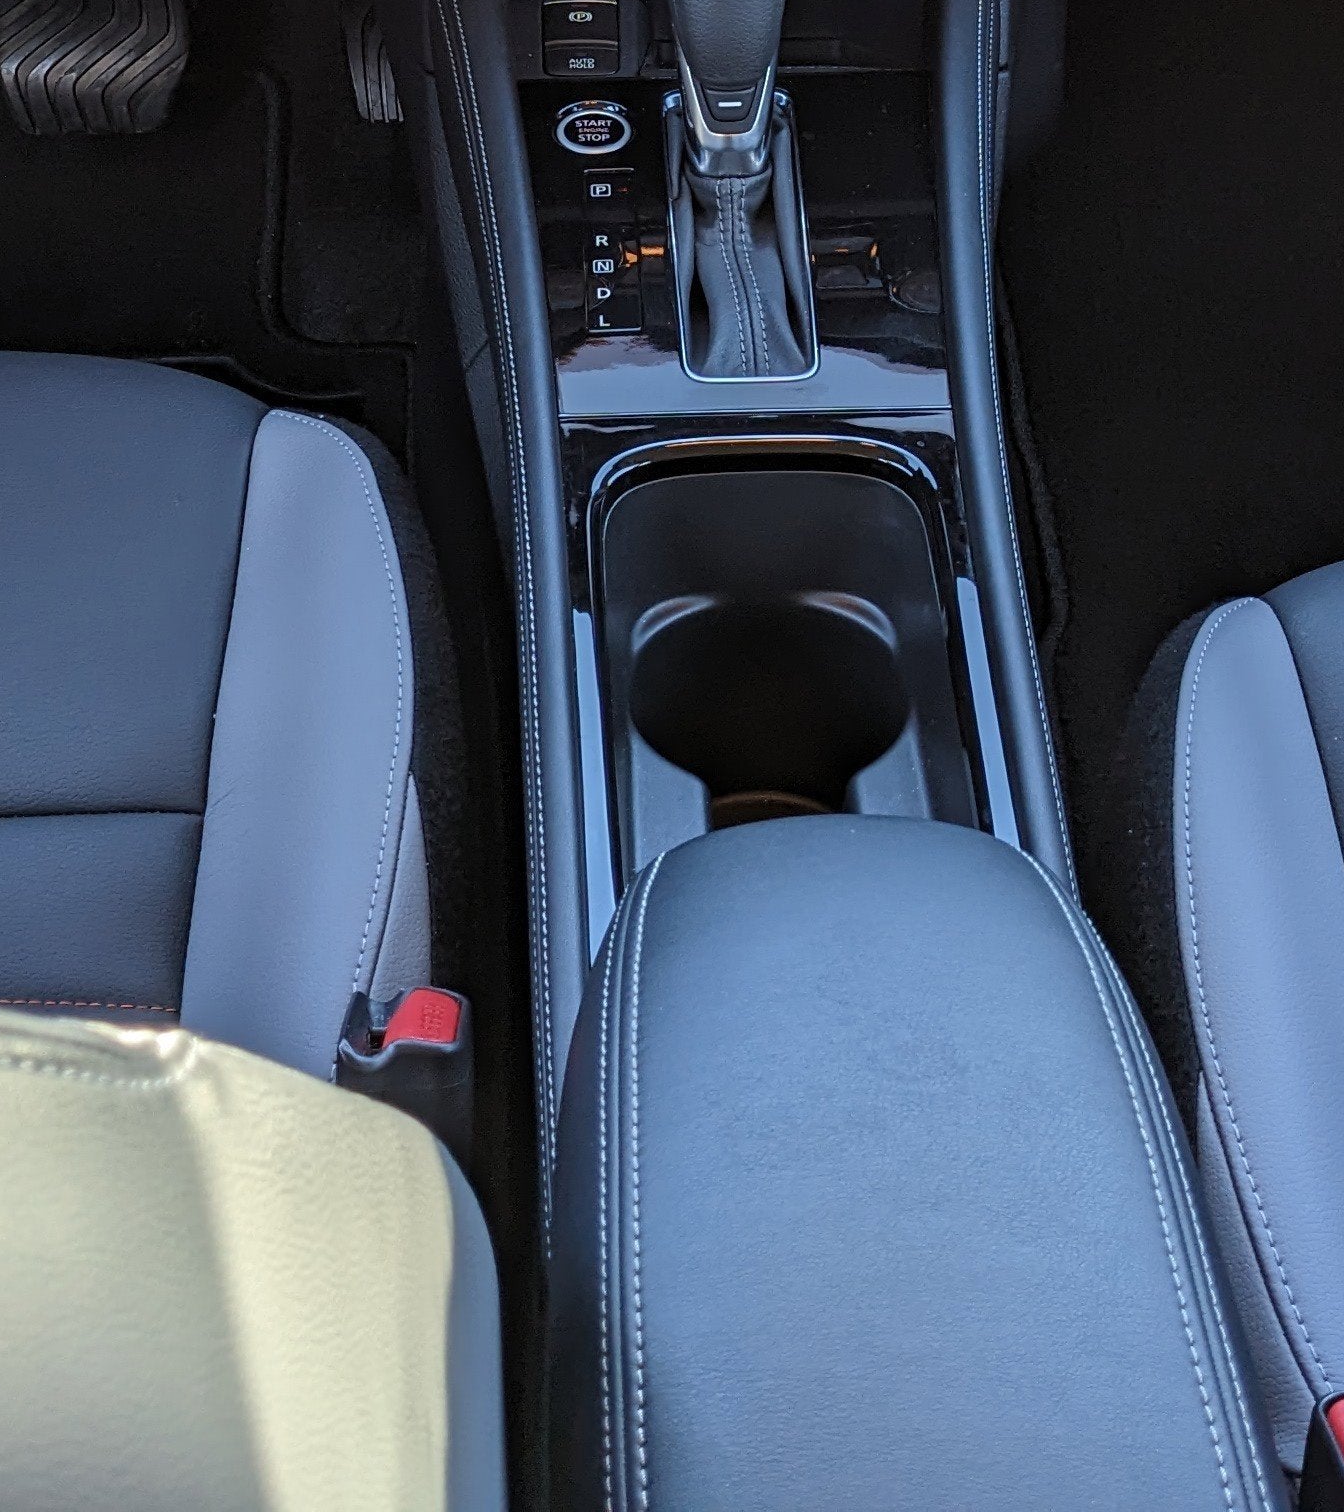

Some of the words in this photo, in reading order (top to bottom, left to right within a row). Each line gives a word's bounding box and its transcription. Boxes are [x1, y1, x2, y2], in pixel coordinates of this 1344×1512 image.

[578, 133, 610, 142] STOP
[596, 235, 609, 247] R
[597, 288, 611, 299] D
[599, 315, 611, 327] L
